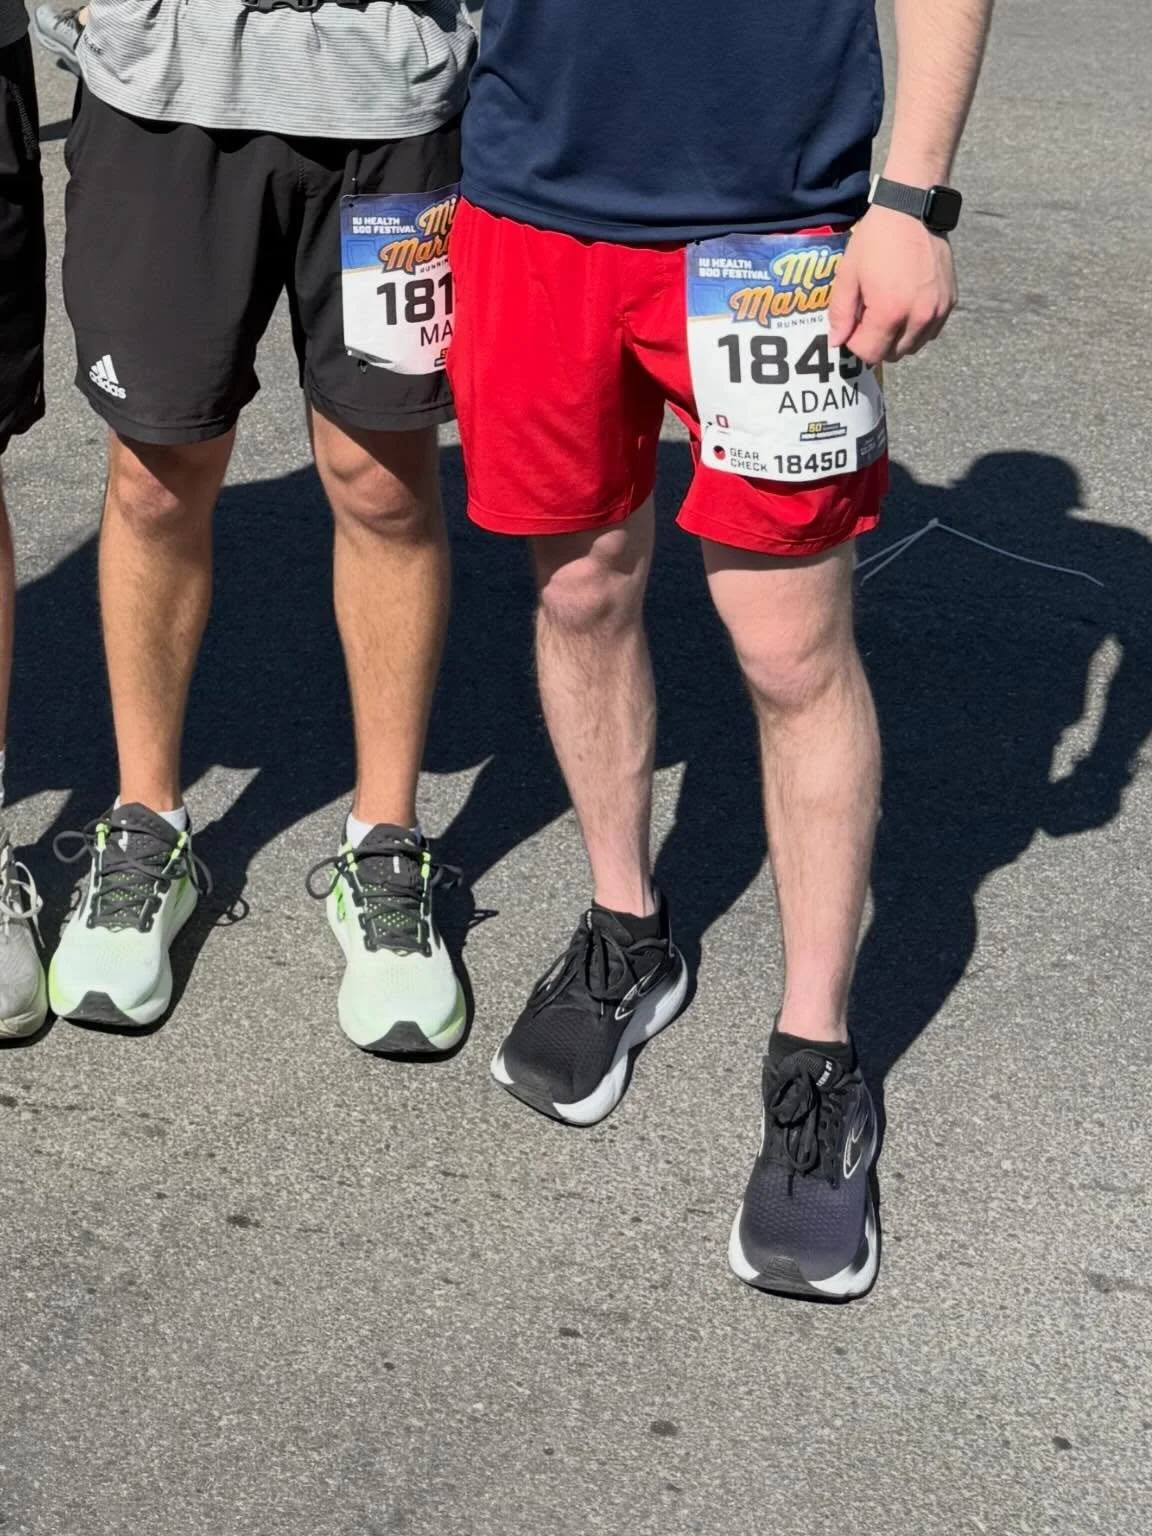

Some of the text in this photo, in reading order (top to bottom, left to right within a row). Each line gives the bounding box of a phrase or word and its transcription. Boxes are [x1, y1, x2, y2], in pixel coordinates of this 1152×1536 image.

[352, 225, 416, 234] 500 FESTIVAL
[364, 217, 400, 225] HEALTH
[712, 258, 752, 269] HEALTH
[699, 268, 771, 281] 500 FESTIVAL
[376, 272, 454, 326] 181
[730, 285, 831, 326] Mara
[776, 316, 824, 329] RUNNING
[420, 322, 454, 347] MA
[717, 334, 864, 384] 1845
[778, 383, 860, 414] ADAM
[730, 447, 848, 475] GEAR 18450
[730, 458, 768, 473] CHECK
